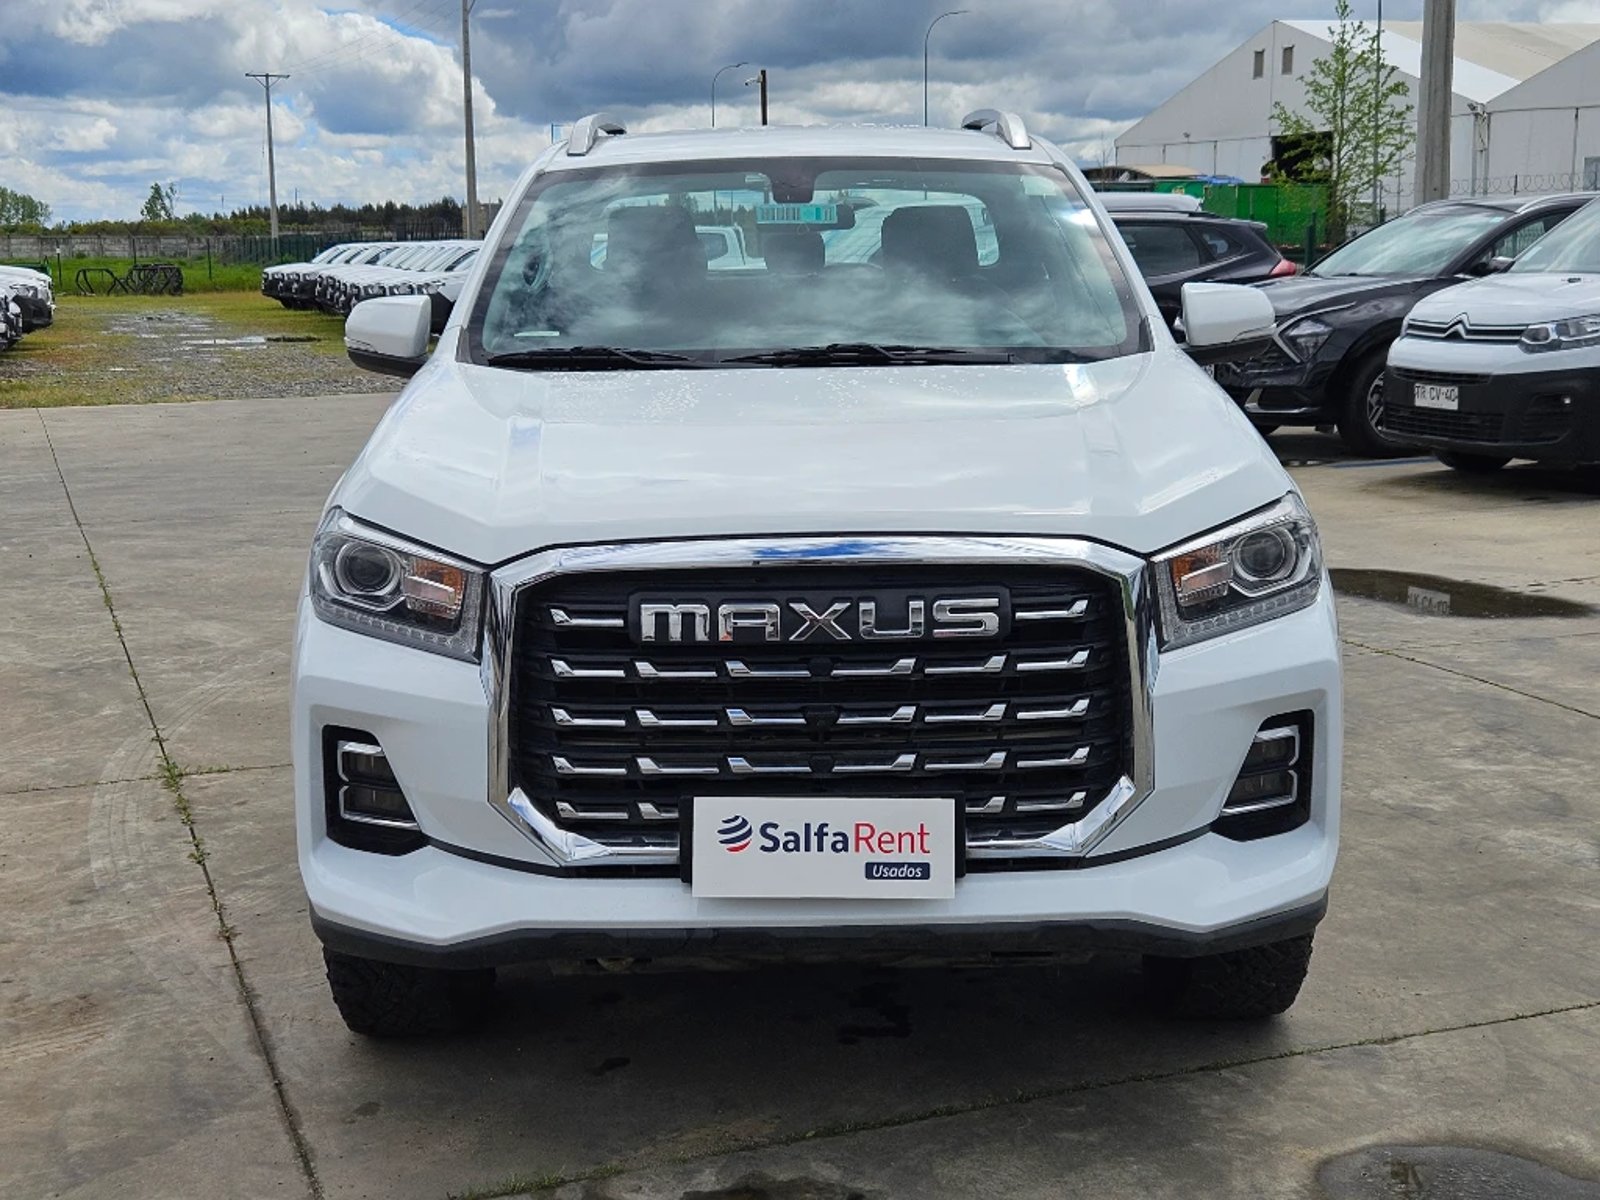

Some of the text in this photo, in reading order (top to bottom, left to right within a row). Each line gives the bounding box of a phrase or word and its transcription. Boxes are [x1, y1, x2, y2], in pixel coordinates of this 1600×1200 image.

[640, 598, 1000, 642] MAXUS
[759, 822, 931, 854] SalfaRent
[872, 865, 922, 878] Usados
